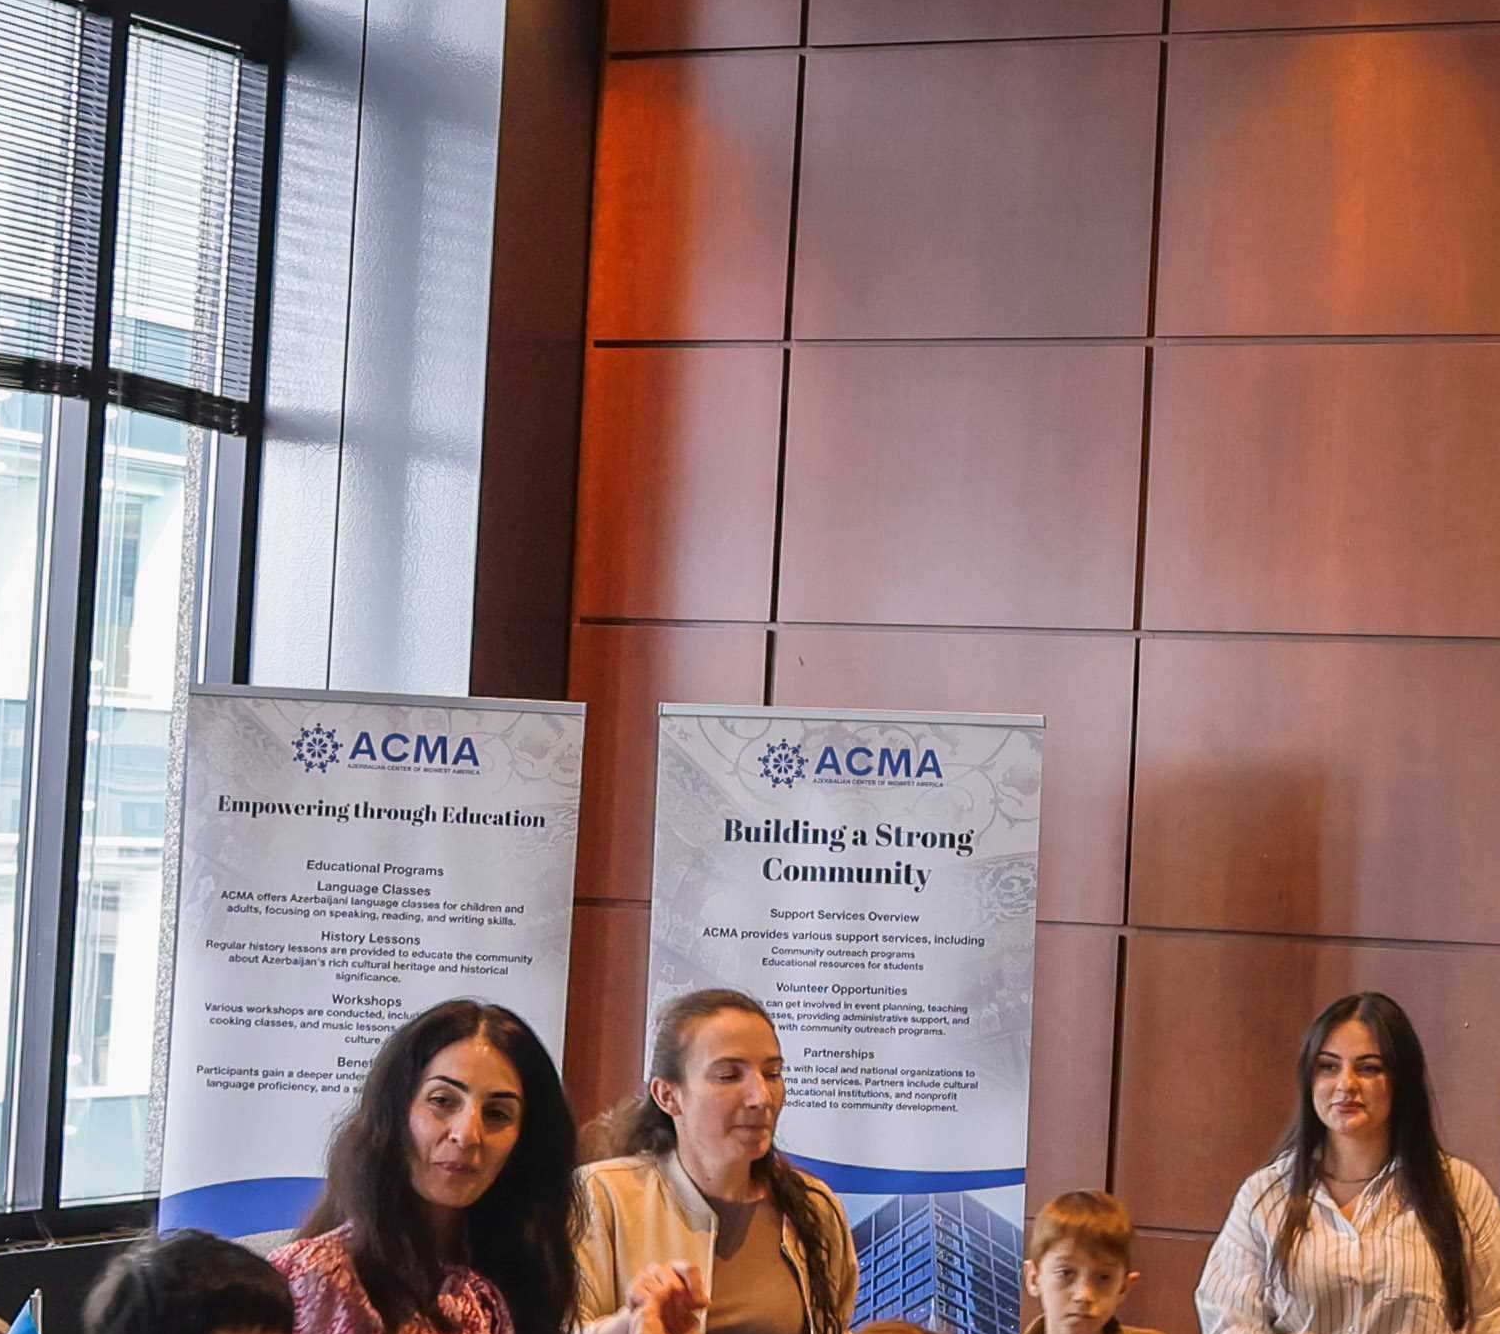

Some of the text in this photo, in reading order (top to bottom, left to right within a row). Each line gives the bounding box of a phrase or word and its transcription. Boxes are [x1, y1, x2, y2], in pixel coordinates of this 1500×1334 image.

[349, 731, 480, 766] ACMA
[814, 746, 943, 778] ACMA
[218, 794, 546, 828] Empowering through Education
[723, 818, 974, 857] Building a Strong
[306, 859, 445, 877] Educational Programs
[762, 857, 932, 893] Community
[317, 881, 431, 896] Language Classes
[221, 891, 525, 914] ACMA offers Azerbaijani language classes for children and
[227, 904, 516, 926] adults, focusing on speaking, reading, and writing skills.
[770, 908, 920, 923] Support Services Overview
[321, 931, 421, 946] History Lessons
[703, 927, 985, 947] ACMA provides various support services, including
[205, 939, 533, 965] Regular history lessons are provided to educate the community
[771, 946, 916, 960] Community outreach programs
[228, 953, 509, 975] about Azerbaijan's rich cultural heritage and historical
[762, 957, 924, 971] Educational resources for students
[335, 971, 402, 983] significance.
[776, 982, 908, 996] Volunteer Opportunities
[332, 993, 402, 1008] Workshops
[766, 1000, 783, 1008] can
[785, 1000, 801, 1010] get
[803, 1000, 841, 1010] involved
[844, 1001, 853, 1010] in
[855, 1002, 881, 1011] event
[883, 1002, 925, 1013] planning,
[928, 1004, 968, 1015] teaching
[205, 1002, 243, 1013] Various
[246, 1004, 304, 1017] workshops
[307, 1008, 324, 1017] are
[326, 1008, 385, 1020] conducted,
[209, 1016, 252, 1028] cooking
[254, 1018, 298, 1029] classes,
[300, 1020, 320, 1030] and
[322, 1021, 353, 1031] music
[771, 1012, 970, 1026] sses, providing administrative support, and
[778, 1022, 946, 1037] with community outreach programs.
[344, 1034, 383, 1046] culture.
[803, 1047, 875, 1060] Partnerships
[196, 1065, 260, 1078] Participants
[262, 1069, 285, 1079] gain
[296, 1070, 333, 1081] deeper
[793, 1064, 814, 1074] with
[815, 1065, 838, 1075] local
[840, 1066, 858, 1075] and
[860, 1067, 898, 1076] national
[900, 1068, 964, 1079] organizations
[966, 1069, 975, 1078] to
[206, 1078, 255, 1091] language
[258, 1080, 318, 1094] proficiency,
[321, 1083, 341, 1093] and
[800, 1076, 818, 1085] and
[820, 1078, 862, 1086] services.
[864, 1078, 904, 1088] Partners
[906, 1079, 941, 1088] include
[943, 1080, 979, 1089] cultural
[786, 1088, 958, 1101] ducational institutions, and nonprofit
[829, 1100, 839, 1109] to
[841, 1101, 893, 1112] community
[895, 1102, 958, 1113] development.
